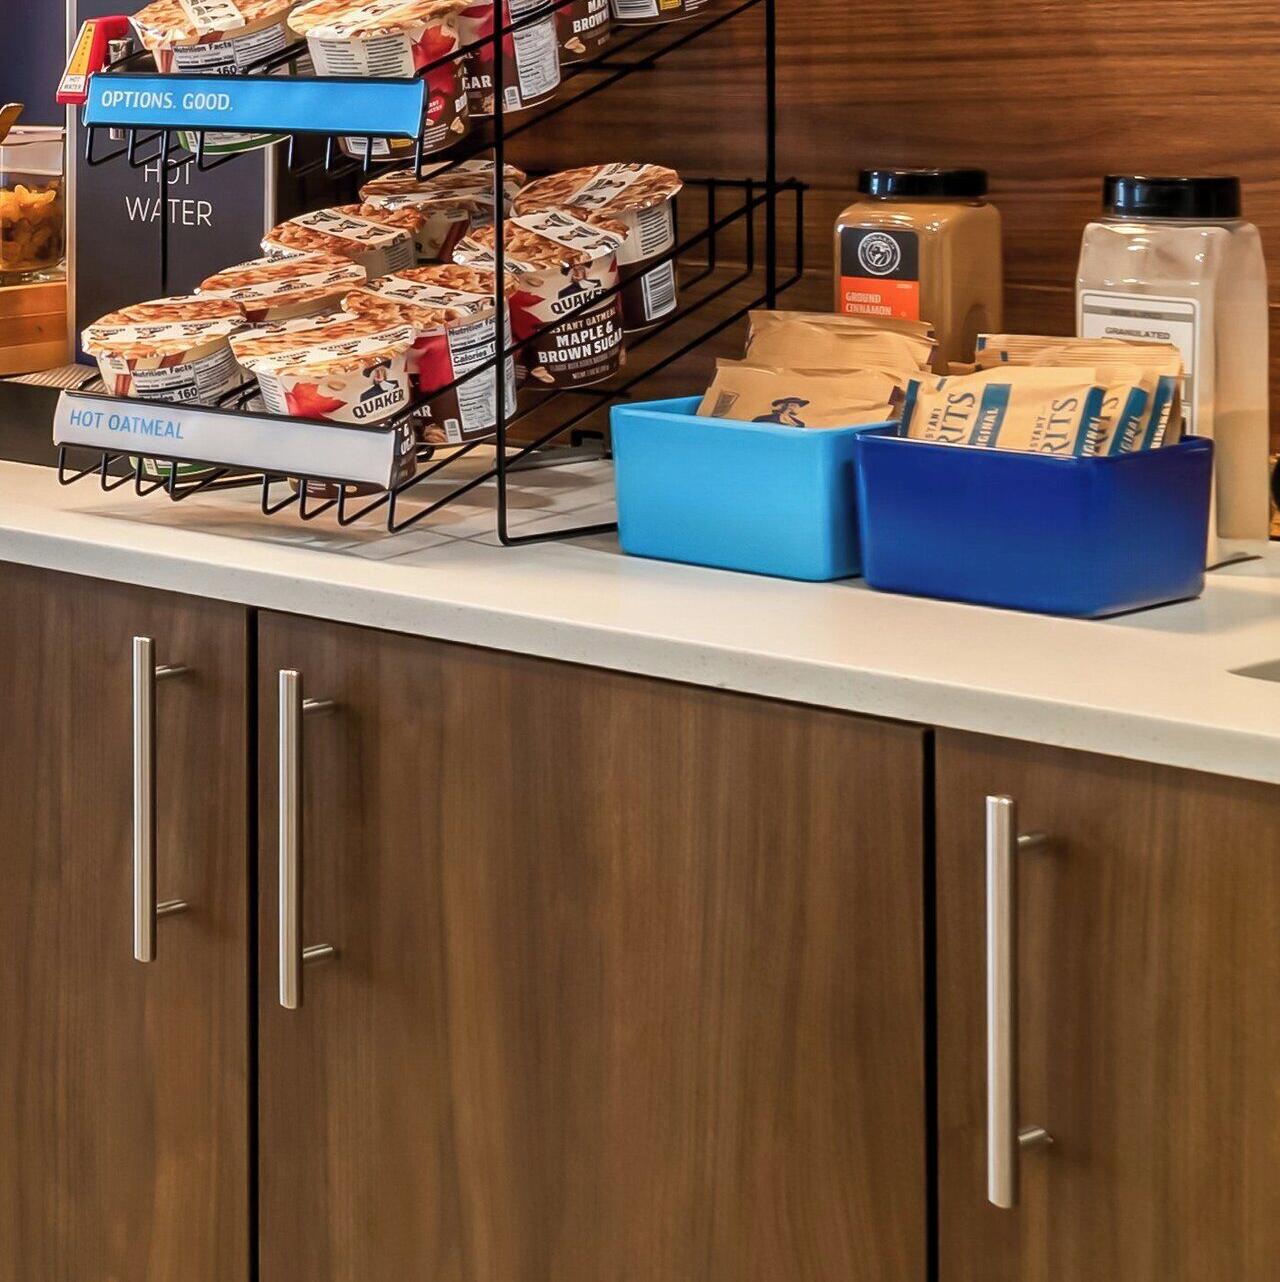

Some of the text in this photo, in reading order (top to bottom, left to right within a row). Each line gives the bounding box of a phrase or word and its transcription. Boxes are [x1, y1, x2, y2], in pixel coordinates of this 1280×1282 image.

[209, 41, 233, 51] Facts
[101, 89, 235, 112] OPTIONS. GOOD.
[144, 158, 195, 185] HOT
[125, 196, 212, 227] WATER
[845, 291, 882, 304] GROUND
[845, 302, 893, 316] CINNAMON
[555, 320, 614, 348] MAPLE &
[1104, 326, 1172, 340] GRANULATED
[453, 350, 487, 364] Calories
[537, 343, 593, 364] BROWN
[132, 364, 193, 379] Nutrition Facts
[177, 387, 199, 400] 160
[351, 388, 405, 419] QUAKER
[69, 409, 185, 440] HOT OATMEAL
